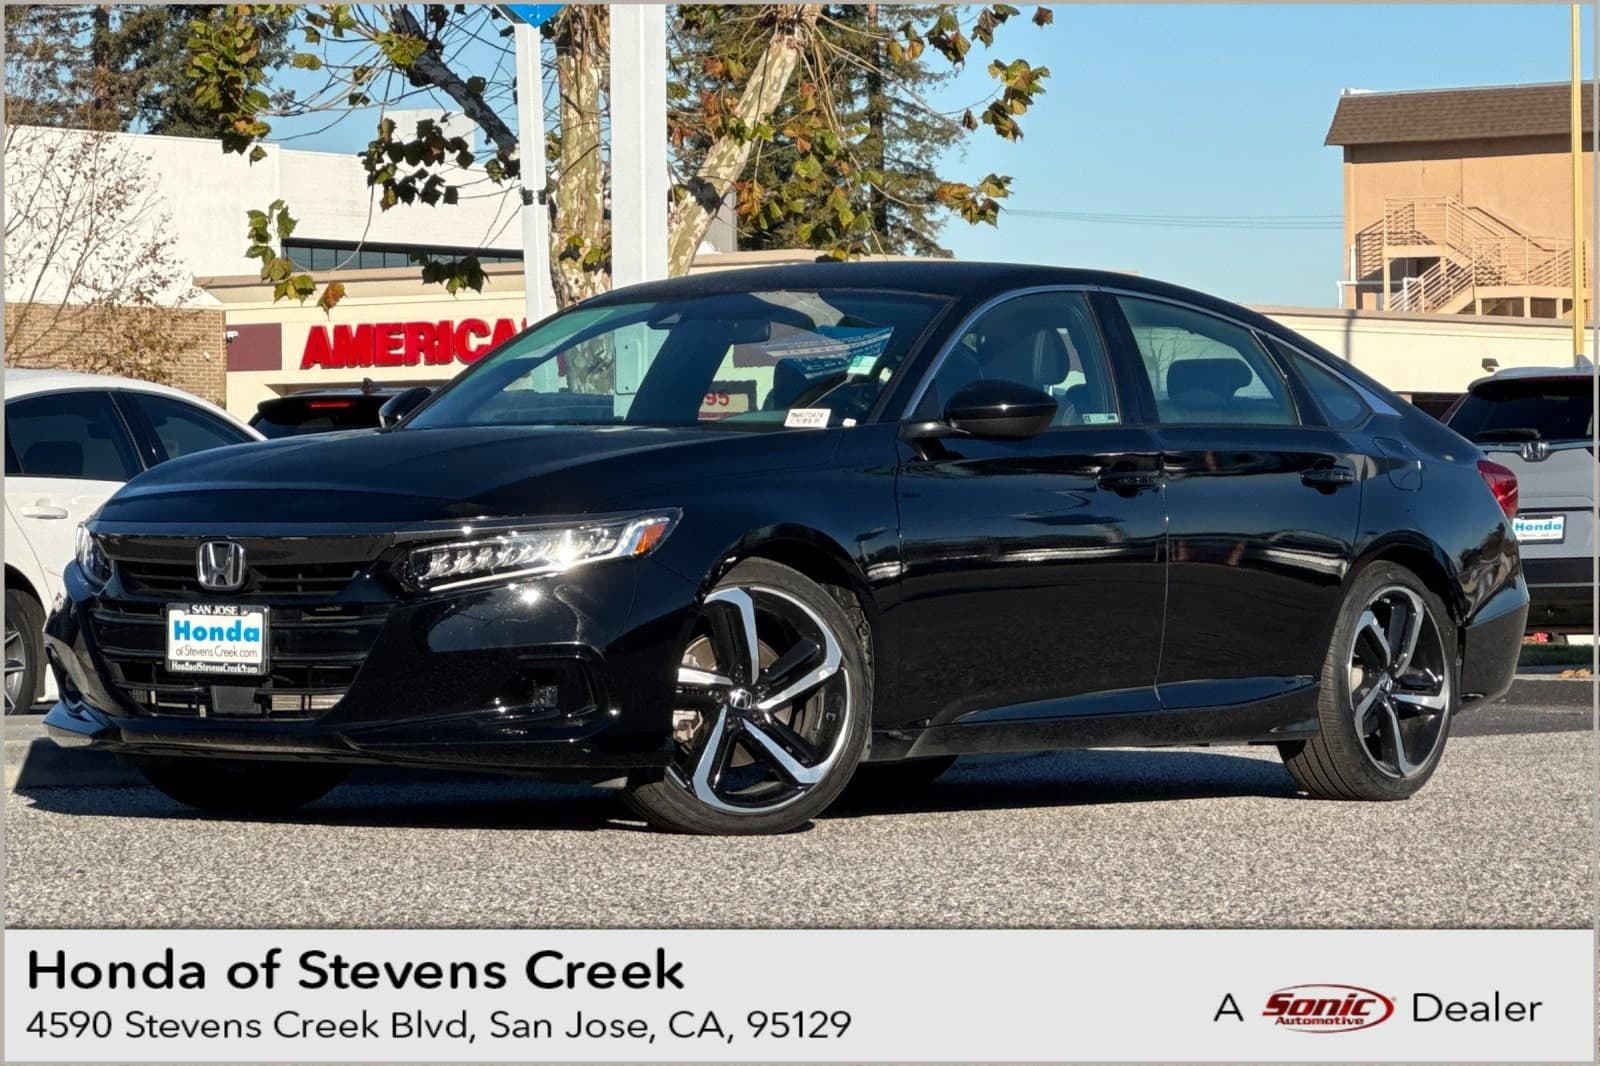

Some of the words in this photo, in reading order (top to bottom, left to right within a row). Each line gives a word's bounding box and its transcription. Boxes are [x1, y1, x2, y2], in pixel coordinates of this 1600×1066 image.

[1514, 520, 1562, 532] Honda
[191, 604, 212, 615] SAN
[213, 605, 239, 616] JOSE
[173, 619, 260, 642] Honda
